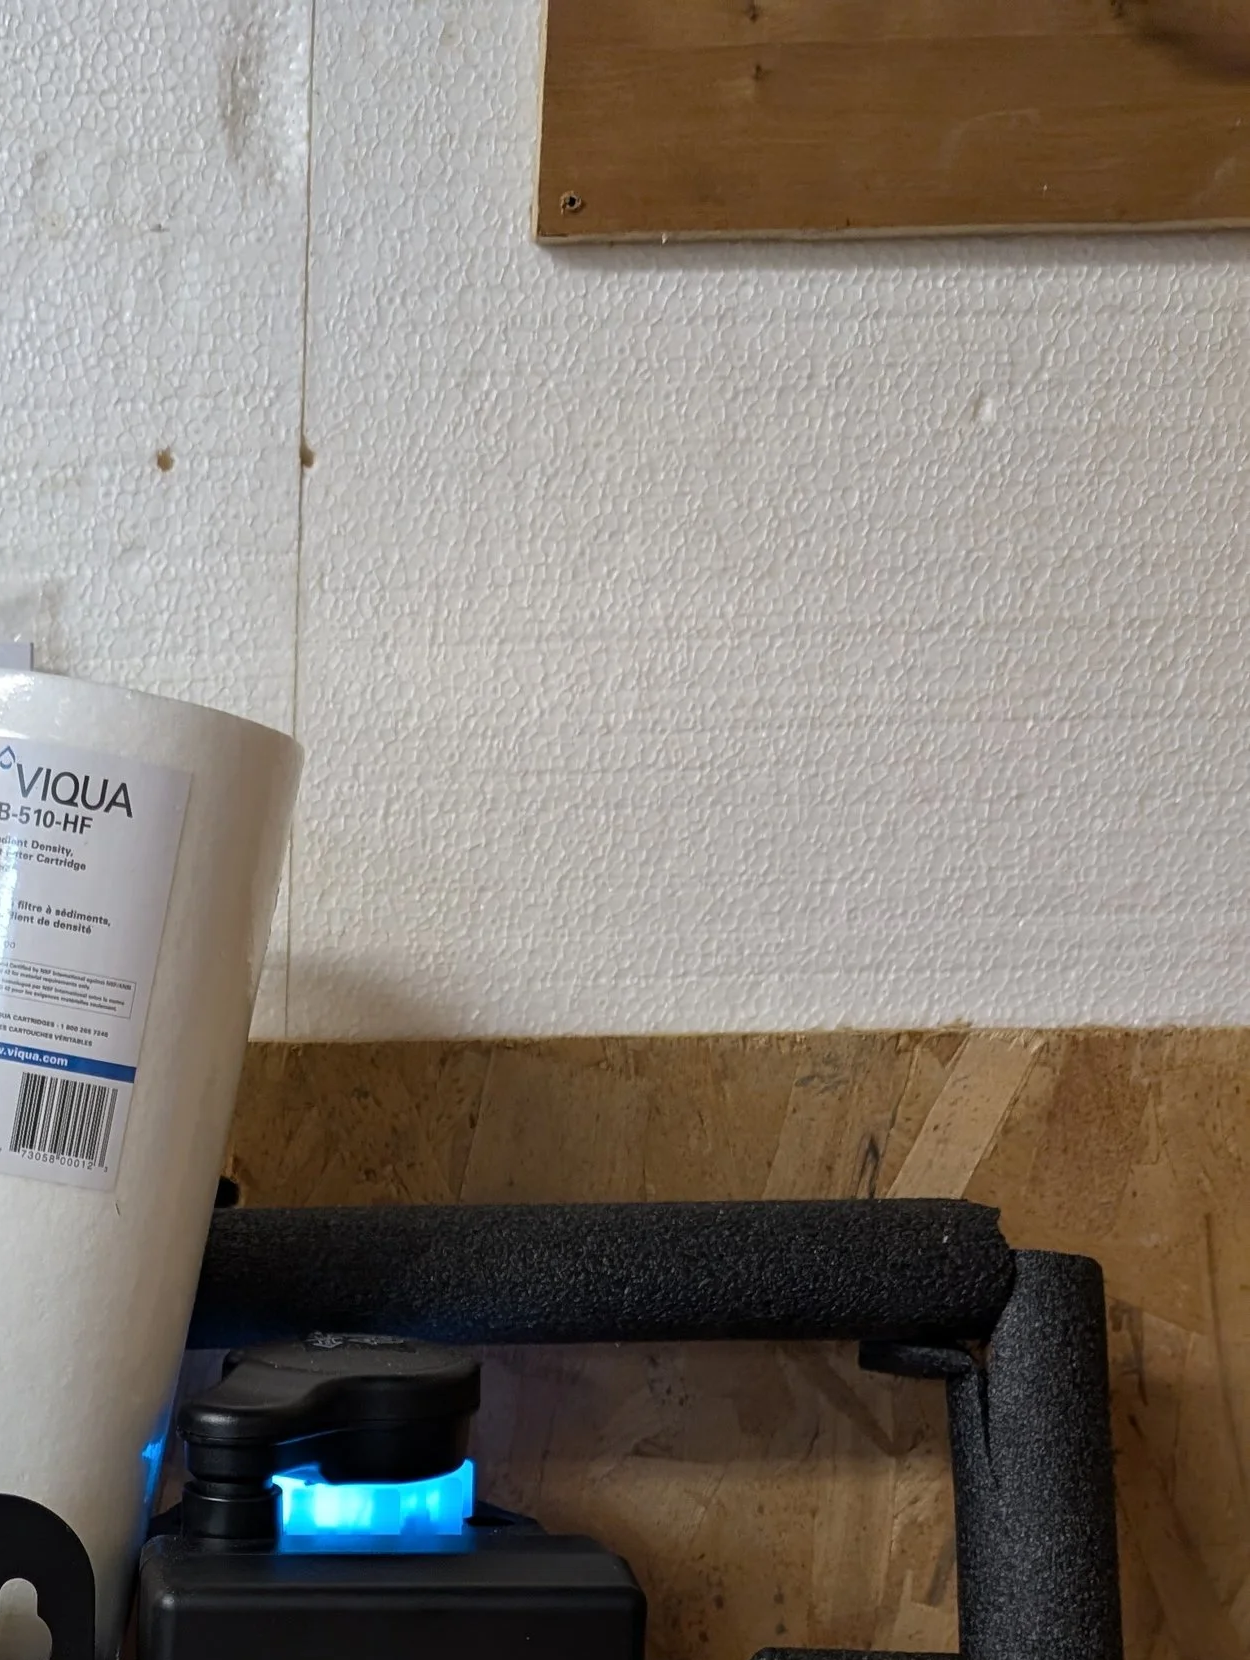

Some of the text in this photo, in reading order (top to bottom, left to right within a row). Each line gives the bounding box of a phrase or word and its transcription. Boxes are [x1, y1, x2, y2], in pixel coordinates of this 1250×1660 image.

[16, 763, 133, 818] VIQUA
[31, 840, 73, 857] Density,
[36, 853, 86, 871] Cartridge
[18, 900, 42, 913] filtre
[55, 906, 111, 927] sédiments,
[37, 916, 50, 926] de
[53, 919, 92, 934] densité
[13, 1014, 55, 1028] CARTRIDGES
[9, 1025, 53, 1039] CARTOUCHES
[21, 1149, 55, 1164] 73058
[60, 1157, 93, 1170] 00012
